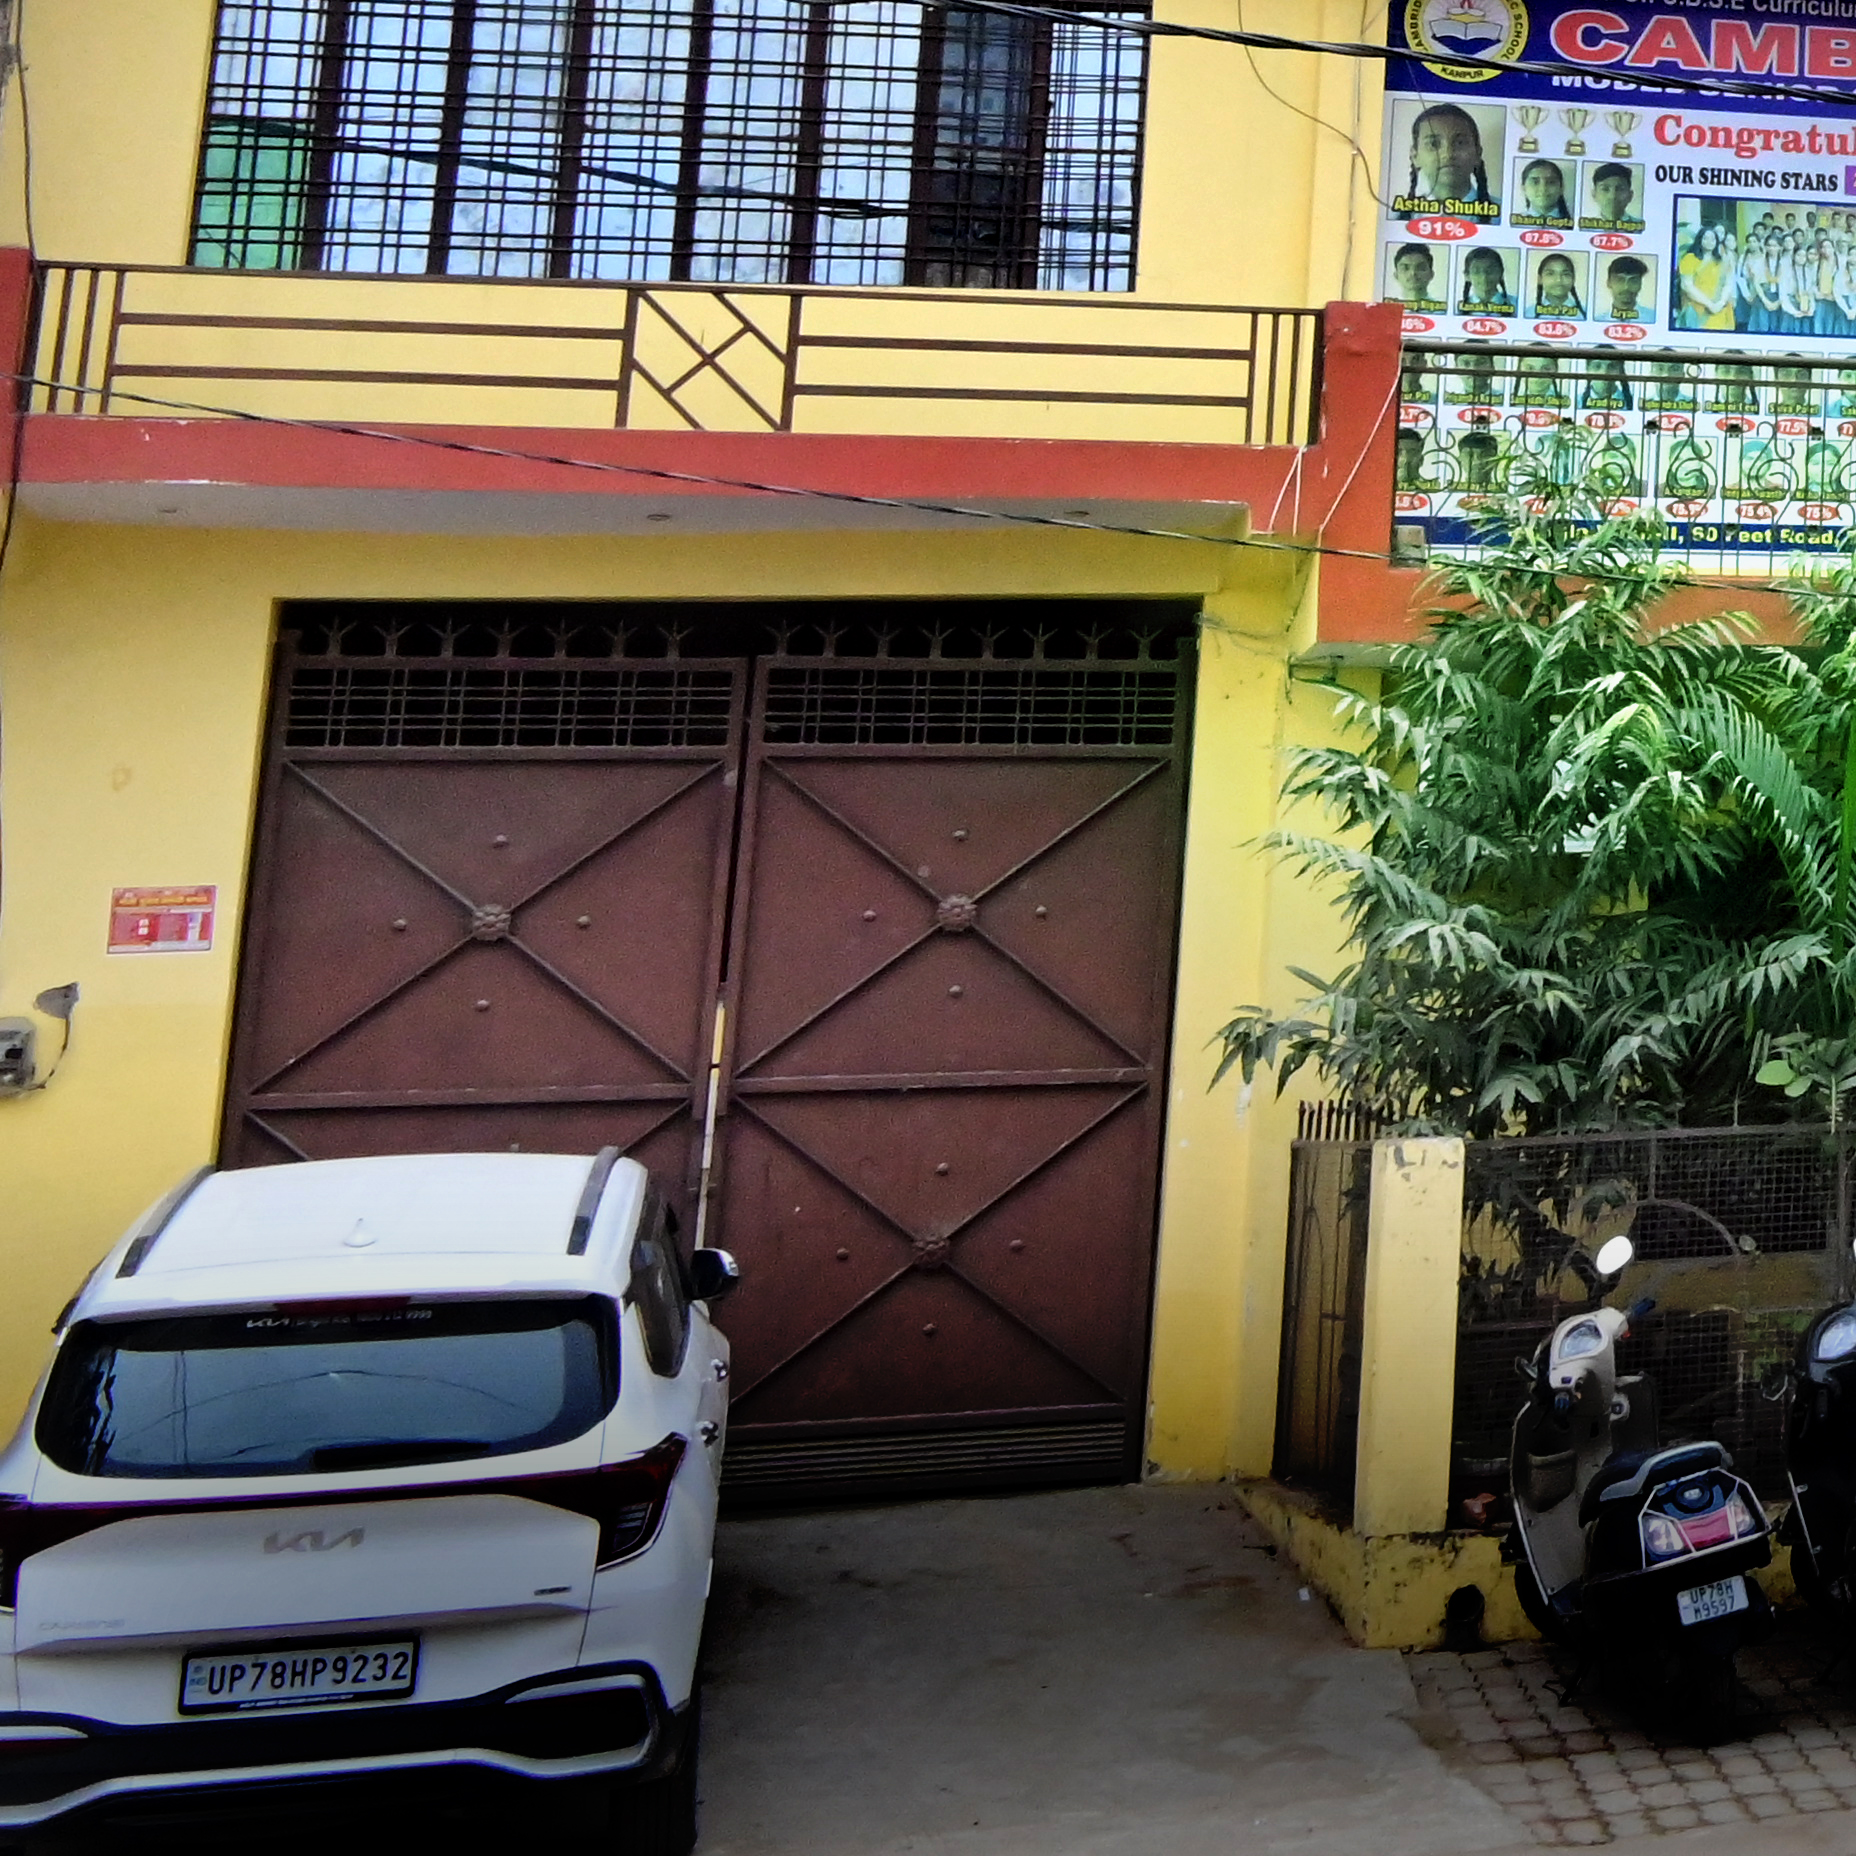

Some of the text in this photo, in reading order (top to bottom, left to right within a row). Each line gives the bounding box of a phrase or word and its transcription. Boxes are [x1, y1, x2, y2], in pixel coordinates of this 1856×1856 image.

[1501, 14, 1524, 60] SCHOOL
[1441, 67, 1485, 79] KANPUR
[1552, 75, 1685, 94] MOD
[1655, 164, 1694, 185] OUR
[1698, 167, 1776, 189] SHINING
[1780, 171, 1839, 193] STARS
[1393, 196, 1499, 217] Astha Shukla
[1417, 221, 1466, 237] 91%
[207, 1649, 411, 1697] UP78HP9232
